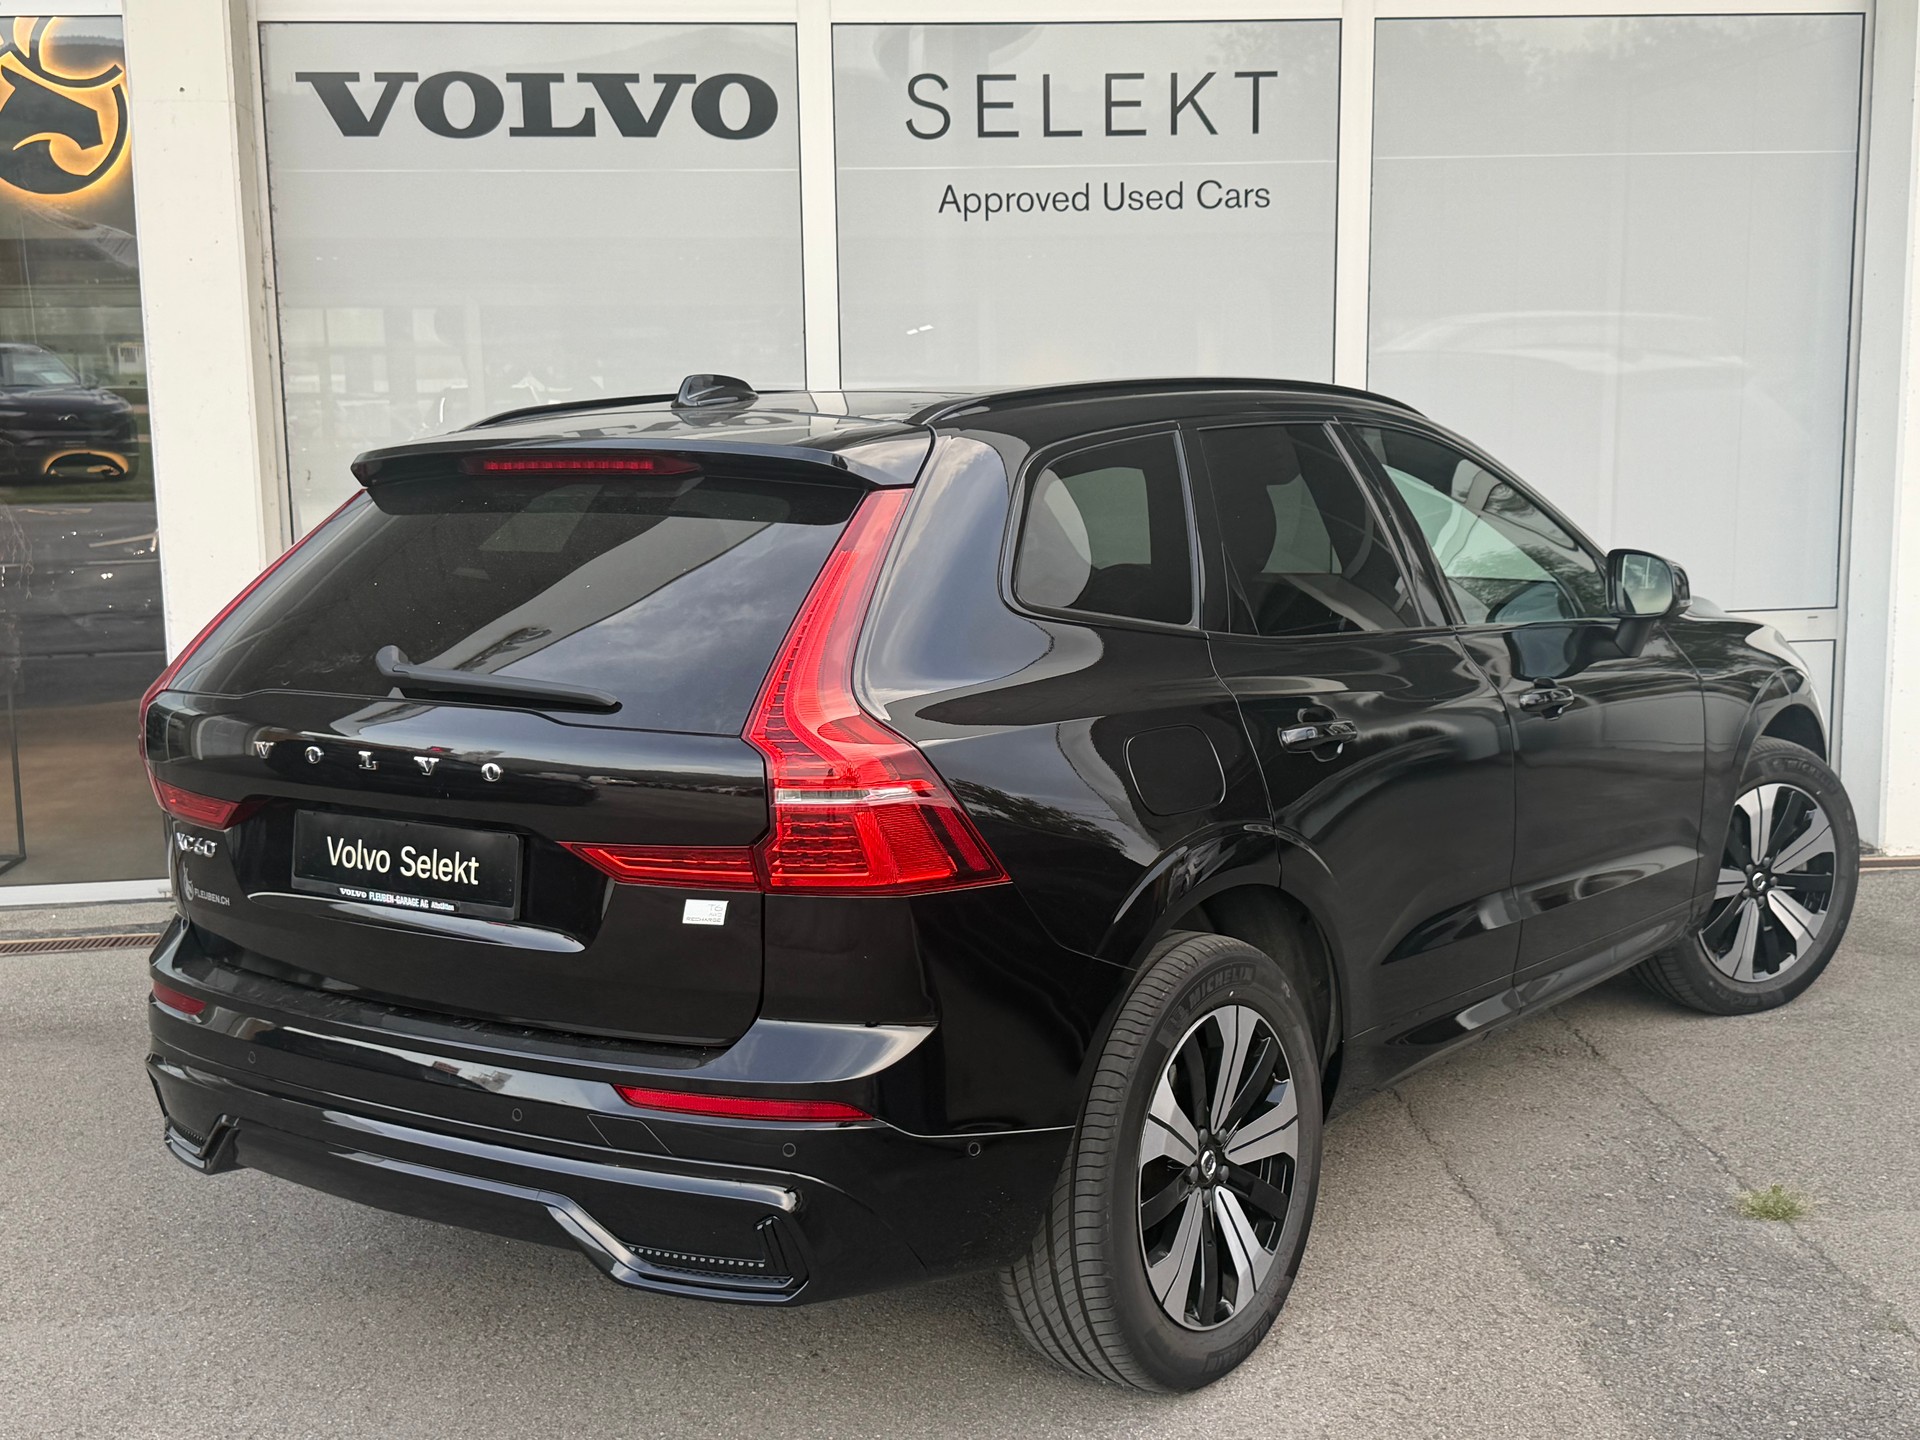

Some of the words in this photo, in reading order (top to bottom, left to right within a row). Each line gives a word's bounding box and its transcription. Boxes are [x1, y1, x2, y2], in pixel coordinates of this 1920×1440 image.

[295, 71, 778, 140] VOLVO
[905, 71, 1279, 140] SELEKT
[938, 182, 1090, 222] Approved
[1103, 181, 1184, 211] Used
[1196, 180, 1271, 210] Cars
[254, 741, 503, 782] VOLVO
[176, 832, 217, 858] XC60
[327, 836, 391, 873] Volvo
[400, 845, 480, 885] Selekt
[194, 887, 231, 906] FLEUBEN.CH
[339, 887, 367, 899] VOLVO
[420, 899, 429, 909] AG
[708, 903, 723, 912] T6
[1188, 965, 1255, 1010] MICHELIN
